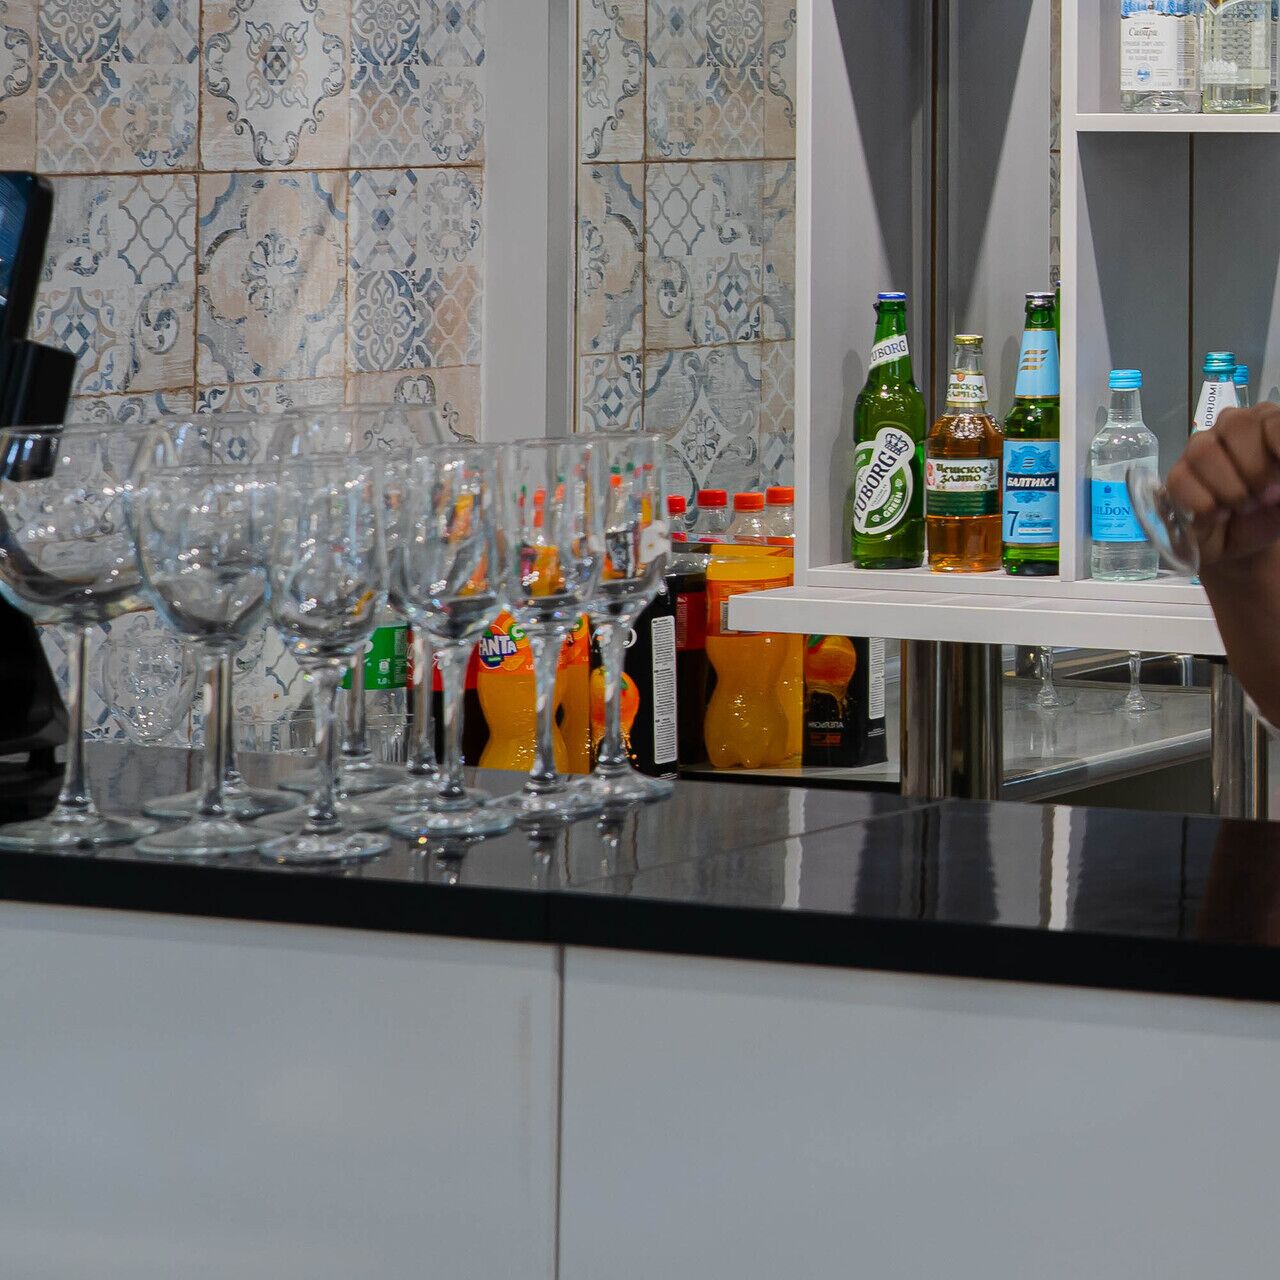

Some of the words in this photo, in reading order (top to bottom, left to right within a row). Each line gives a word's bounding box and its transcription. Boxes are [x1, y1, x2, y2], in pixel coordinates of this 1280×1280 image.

[871, 339, 906, 362] UBORG
[1204, 384, 1217, 427] BORJOMI
[936, 463, 989, 474] Чешское
[853, 451, 898, 521] TUBORG
[1007, 477, 1056, 488] БАЛТИКА
[883, 491, 904, 518] GREEN
[1095, 506, 1130, 516] ILDON
[1007, 510, 1020, 537] 7
[479, 634, 518, 657] ANTA
